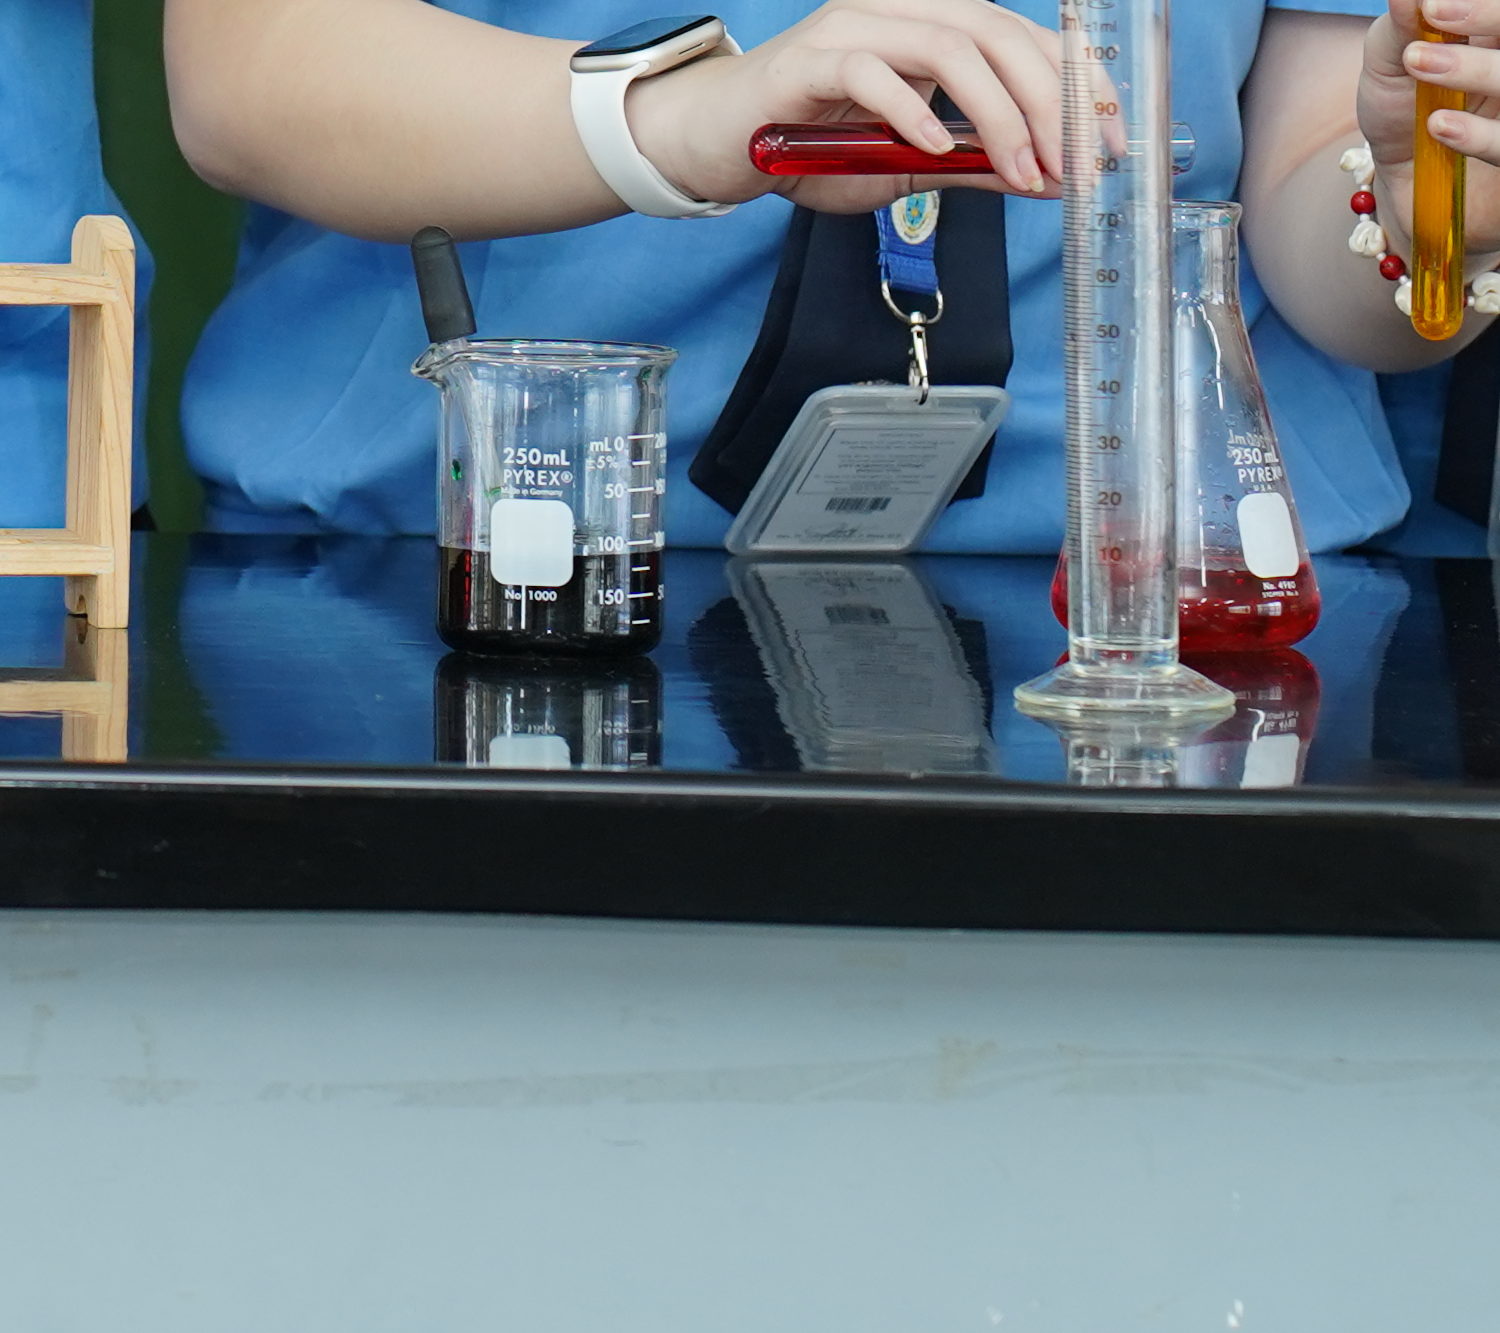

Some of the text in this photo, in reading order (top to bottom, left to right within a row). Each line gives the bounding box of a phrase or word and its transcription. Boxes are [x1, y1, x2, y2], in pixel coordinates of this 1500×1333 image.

[1085, 45, 1119, 61] 100
[1094, 102, 1118, 116] 90
[1095, 158, 1118, 173] 80
[1097, 214, 1119, 228] 70
[1096, 269, 1119, 284] 60
[1097, 325, 1120, 339] 50
[1097, 380, 1121, 395] 40
[590, 436, 625, 453] mL 0
[1098, 436, 1121, 450] 30
[1233, 443, 1280, 466] 250 mL
[586, 455, 620, 470] ±5%
[530, 487, 564, 498] Germany
[604, 483, 625, 499] 50
[1098, 492, 1122, 507] 20
[597, 536, 625, 552] 100
[1100, 547, 1122, 562] 10
[528, 589, 558, 602] 1000
[597, 589, 625, 605] 150
